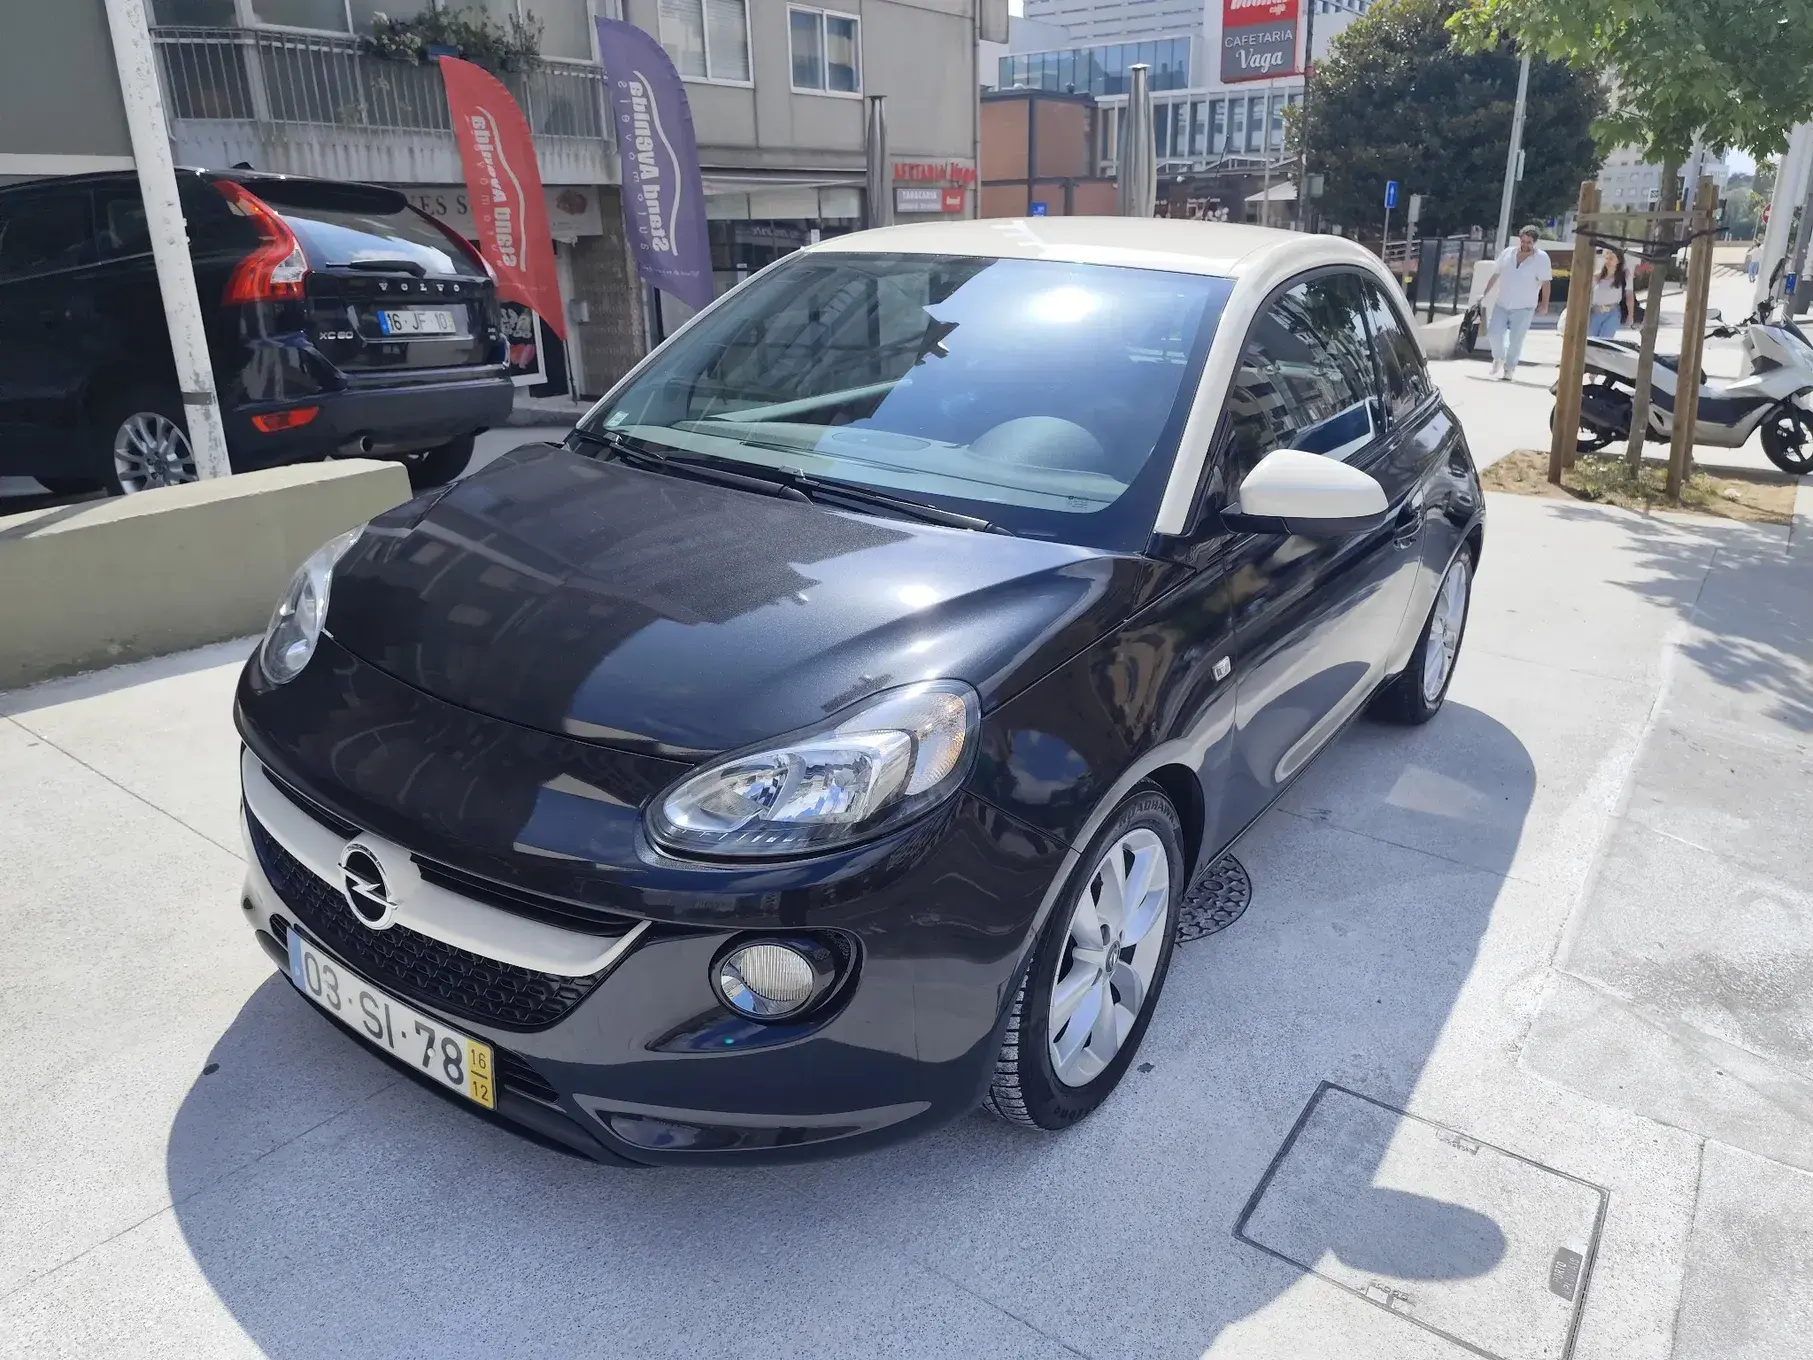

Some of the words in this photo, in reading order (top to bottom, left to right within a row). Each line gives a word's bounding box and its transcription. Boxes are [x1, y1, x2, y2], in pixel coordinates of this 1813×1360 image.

[1224, 29, 1293, 48] CAFETARIA
[1236, 48, 1284, 73] Vaga
[379, 282, 461, 293] VOLVO
[319, 330, 354, 341] XC60
[471, 1048, 487, 1070] 16
[473, 1080, 489, 1102] 12
